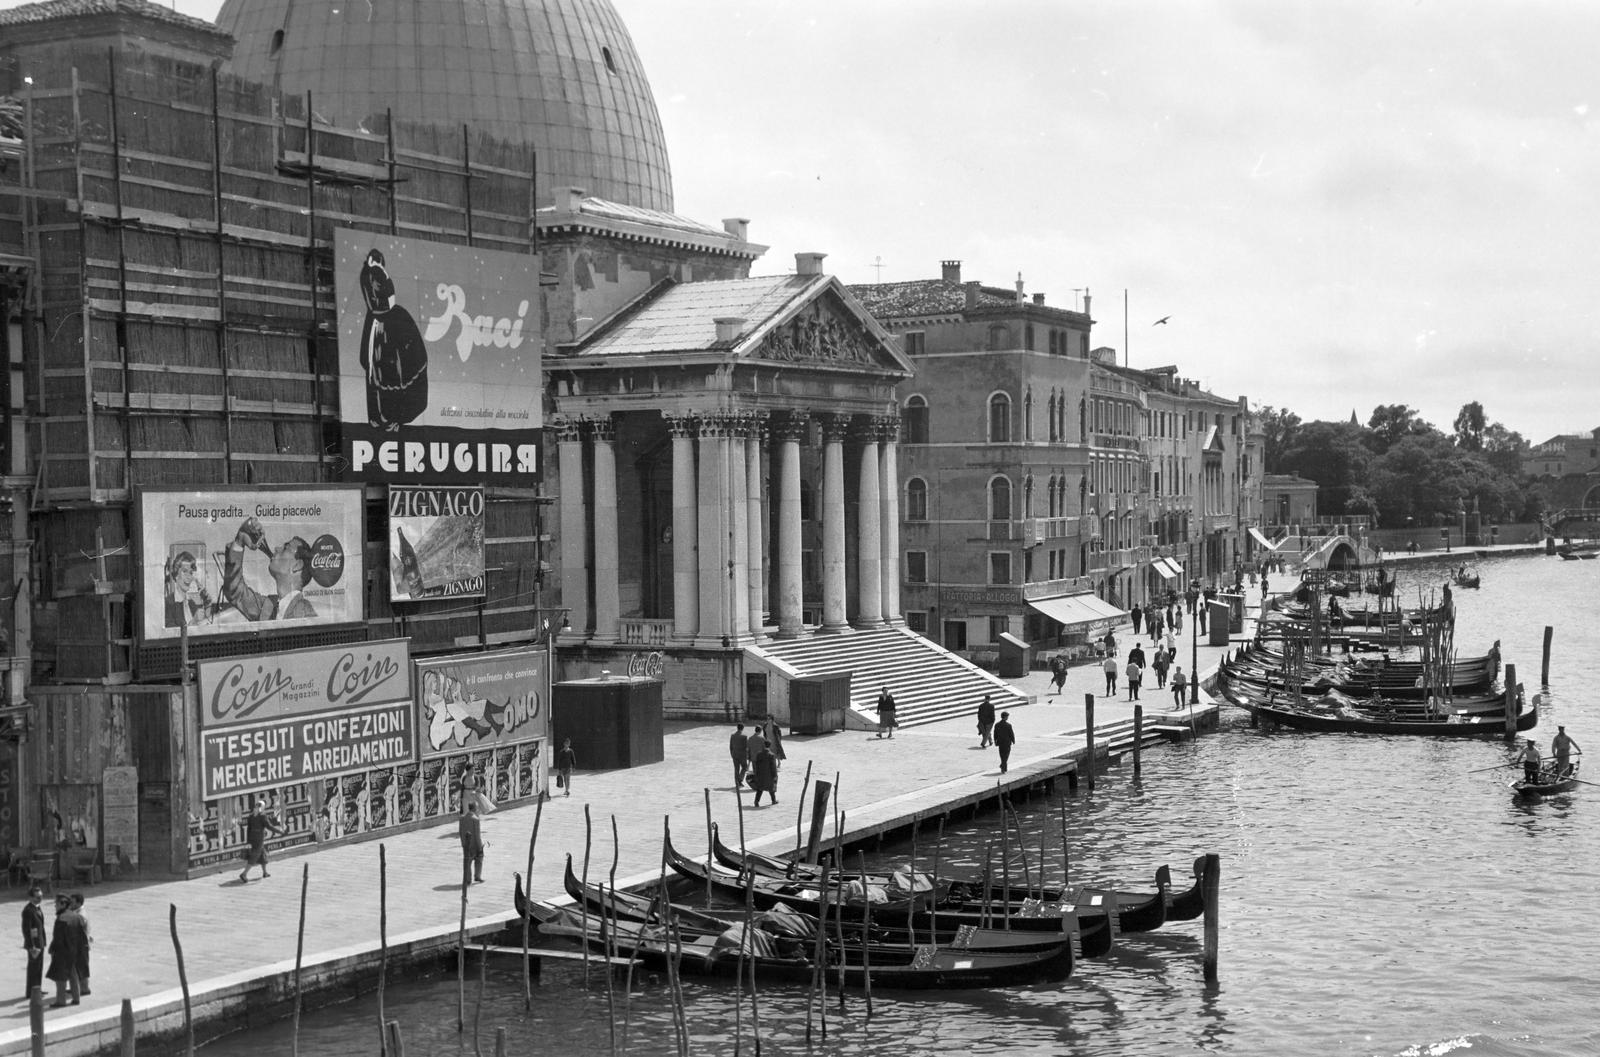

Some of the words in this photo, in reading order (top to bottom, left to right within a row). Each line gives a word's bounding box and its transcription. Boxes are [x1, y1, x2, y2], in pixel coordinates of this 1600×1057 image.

[424, 283, 529, 362] Baci
[352, 440, 537, 473] PERUGINA
[178, 504, 210, 519] Pausa
[255, 504, 280, 518] Guida
[282, 504, 322, 520] piacevole
[389, 490, 484, 518] ZIGNAGO
[443, 575, 483, 596] ZIGNAGO
[211, 663, 293, 719] Coin
[326, 653, 399, 704] Coin
[290, 679, 315, 691] Grandi
[471, 674, 476, 685] il
[477, 673, 503, 684] confronto
[504, 671, 514, 680] che
[515, 668, 538, 679] convince
[282, 689, 320, 702] Magazzini
[503, 690, 540, 732] OMO
[302, 709, 405, 745] CONFEZIONI
[212, 755, 293, 791] MERCERIE
